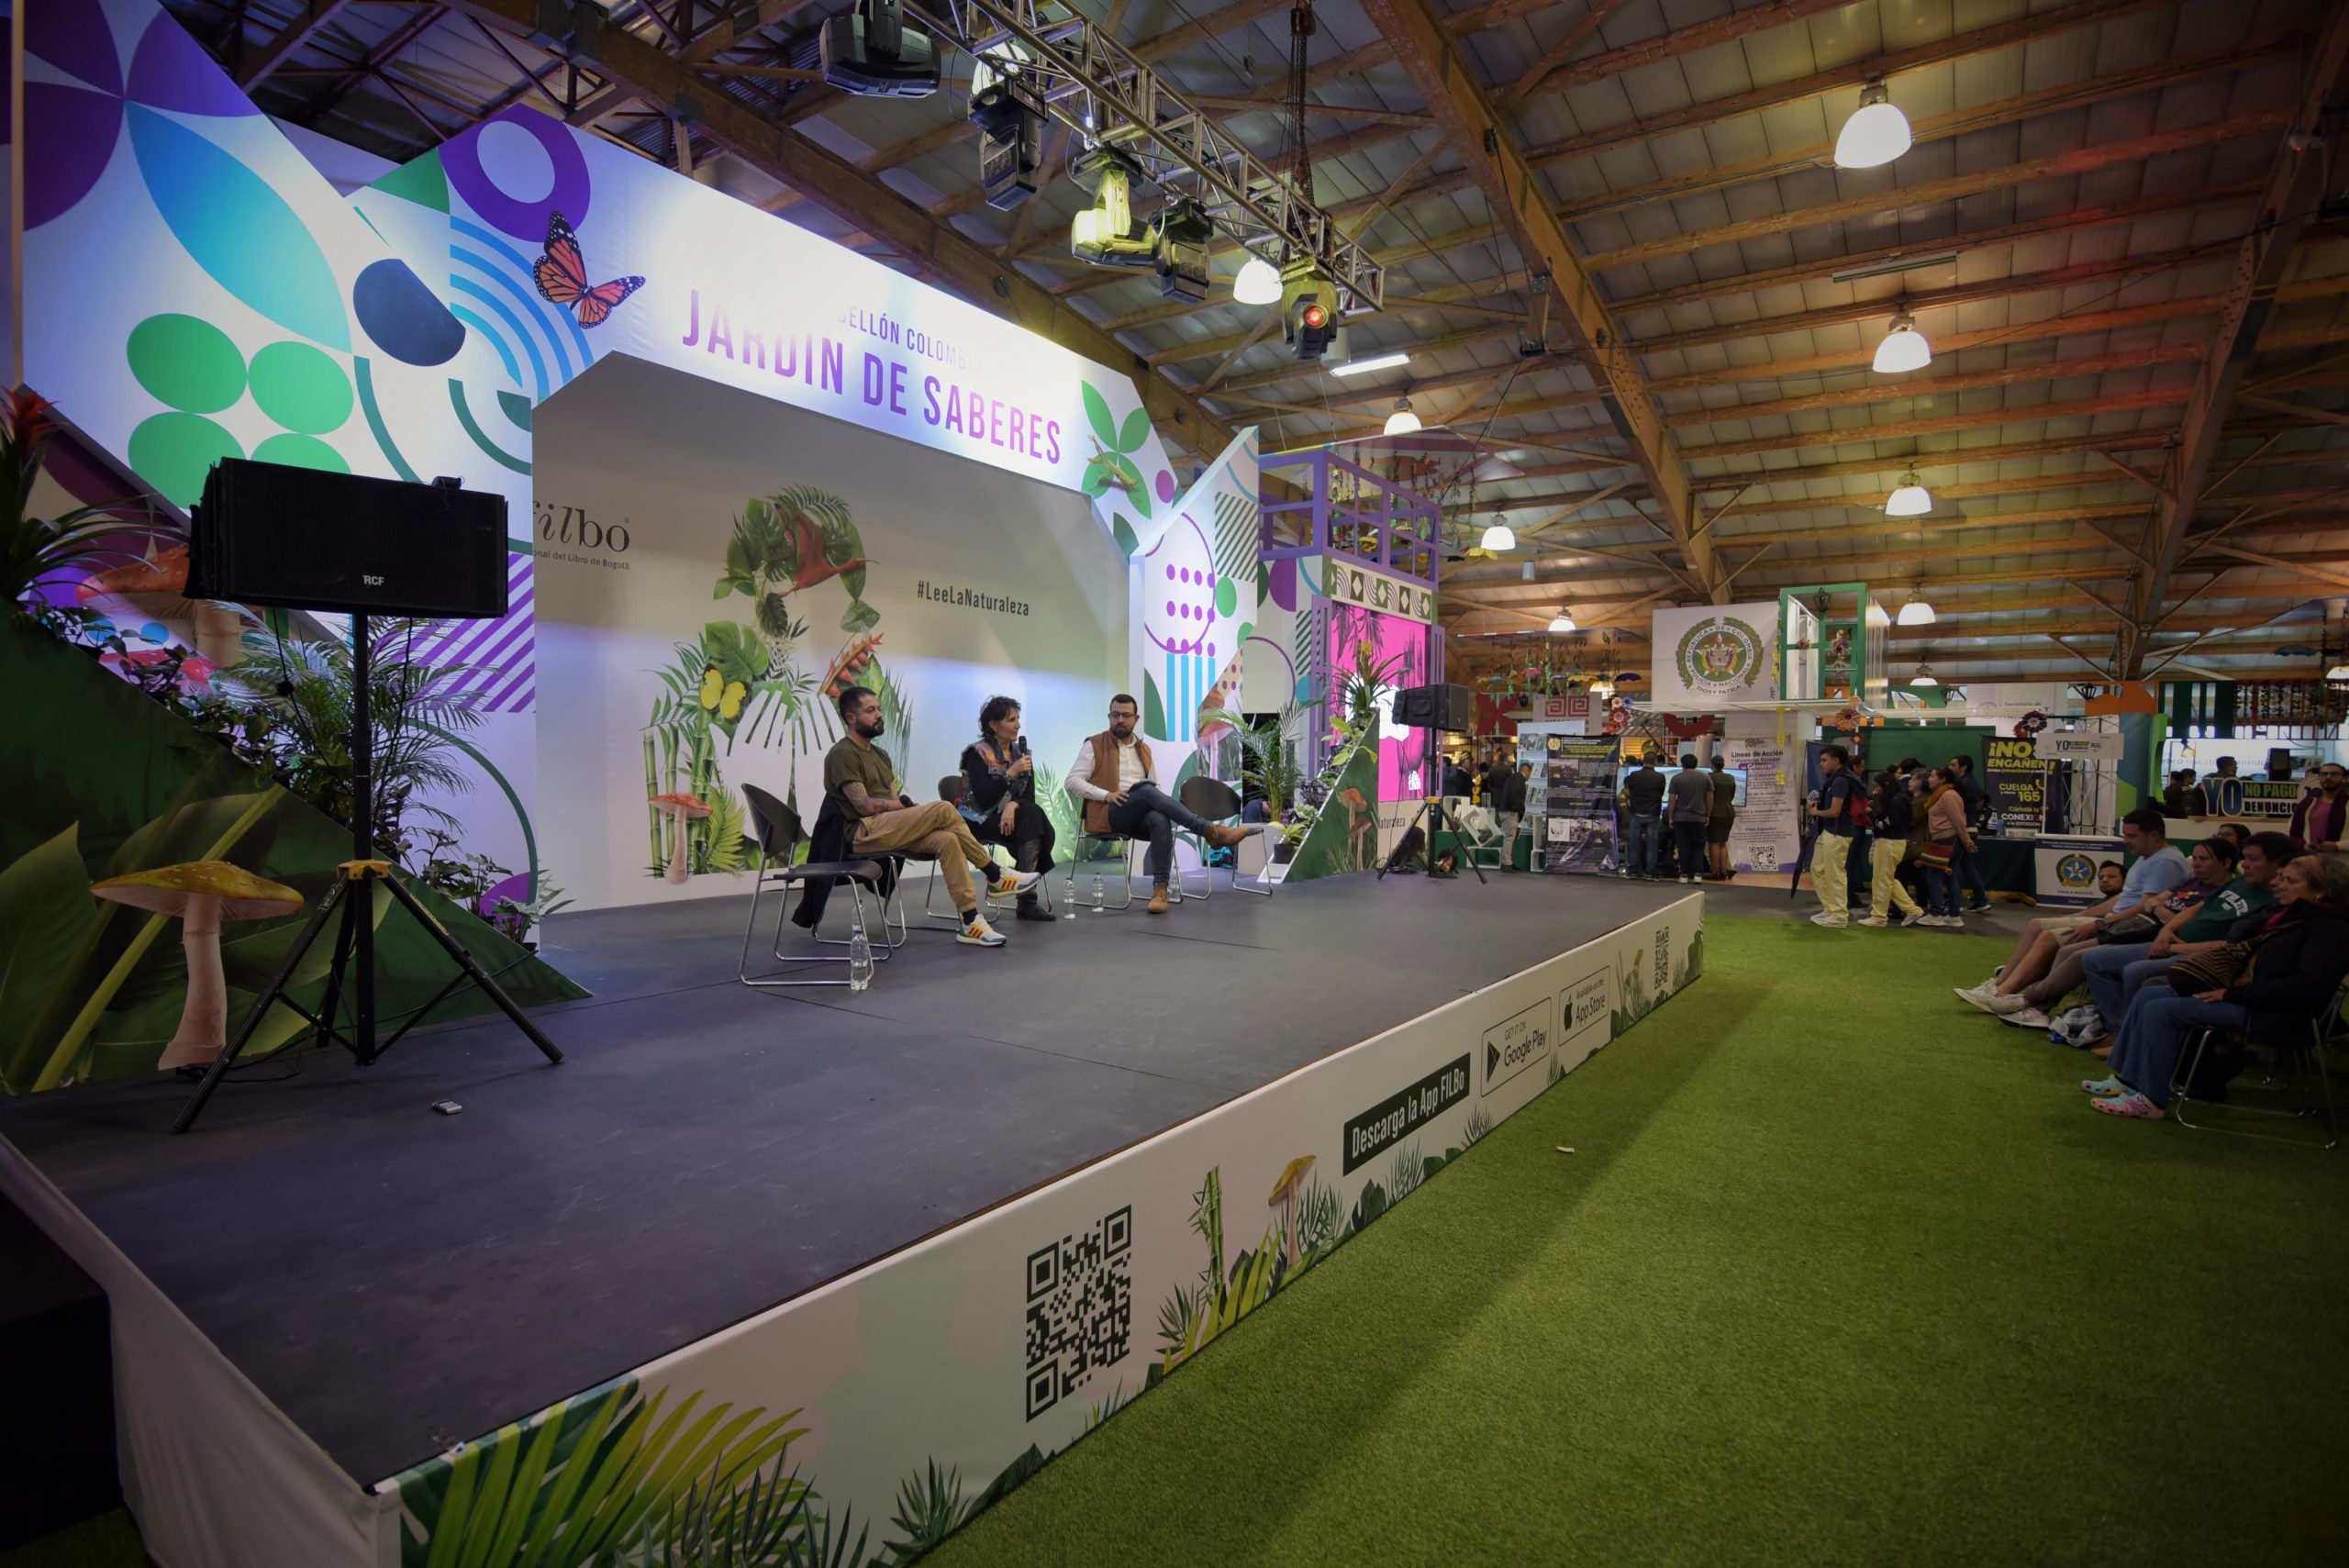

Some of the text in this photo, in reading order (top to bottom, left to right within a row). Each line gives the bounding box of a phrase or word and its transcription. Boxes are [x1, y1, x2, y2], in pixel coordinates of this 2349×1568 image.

[863, 351, 908, 417] DE
[923, 375, 1061, 465] SABERES
[552, 552, 566, 561] del
[568, 554, 589, 564] Libro
[590, 558, 601, 566] de
[602, 559, 630, 571] Bogotá
[362, 574, 385, 586] RCF
[918, 580, 1030, 617] #LeeLaNaturaleza
[1732, 628, 1753, 661] COLOMBIA
[1989, 740, 2032, 759] ¡NO
[2056, 740, 2070, 751] YO
[1999, 783, 2034, 791] CUELGA
[2019, 791, 2041, 802] 165
[2201, 776, 2296, 817] YO NO PAGO
[1378, 817, 1405, 828] aturaleza
[1575, 995, 1605, 1028] App Store
[1504, 1027, 1513, 1040] GET
[1519, 1020, 1526, 1032] ON
[1504, 1028, 1546, 1065] Google Play
[1352, 1068, 1465, 1159] Descarga la App FILBo
